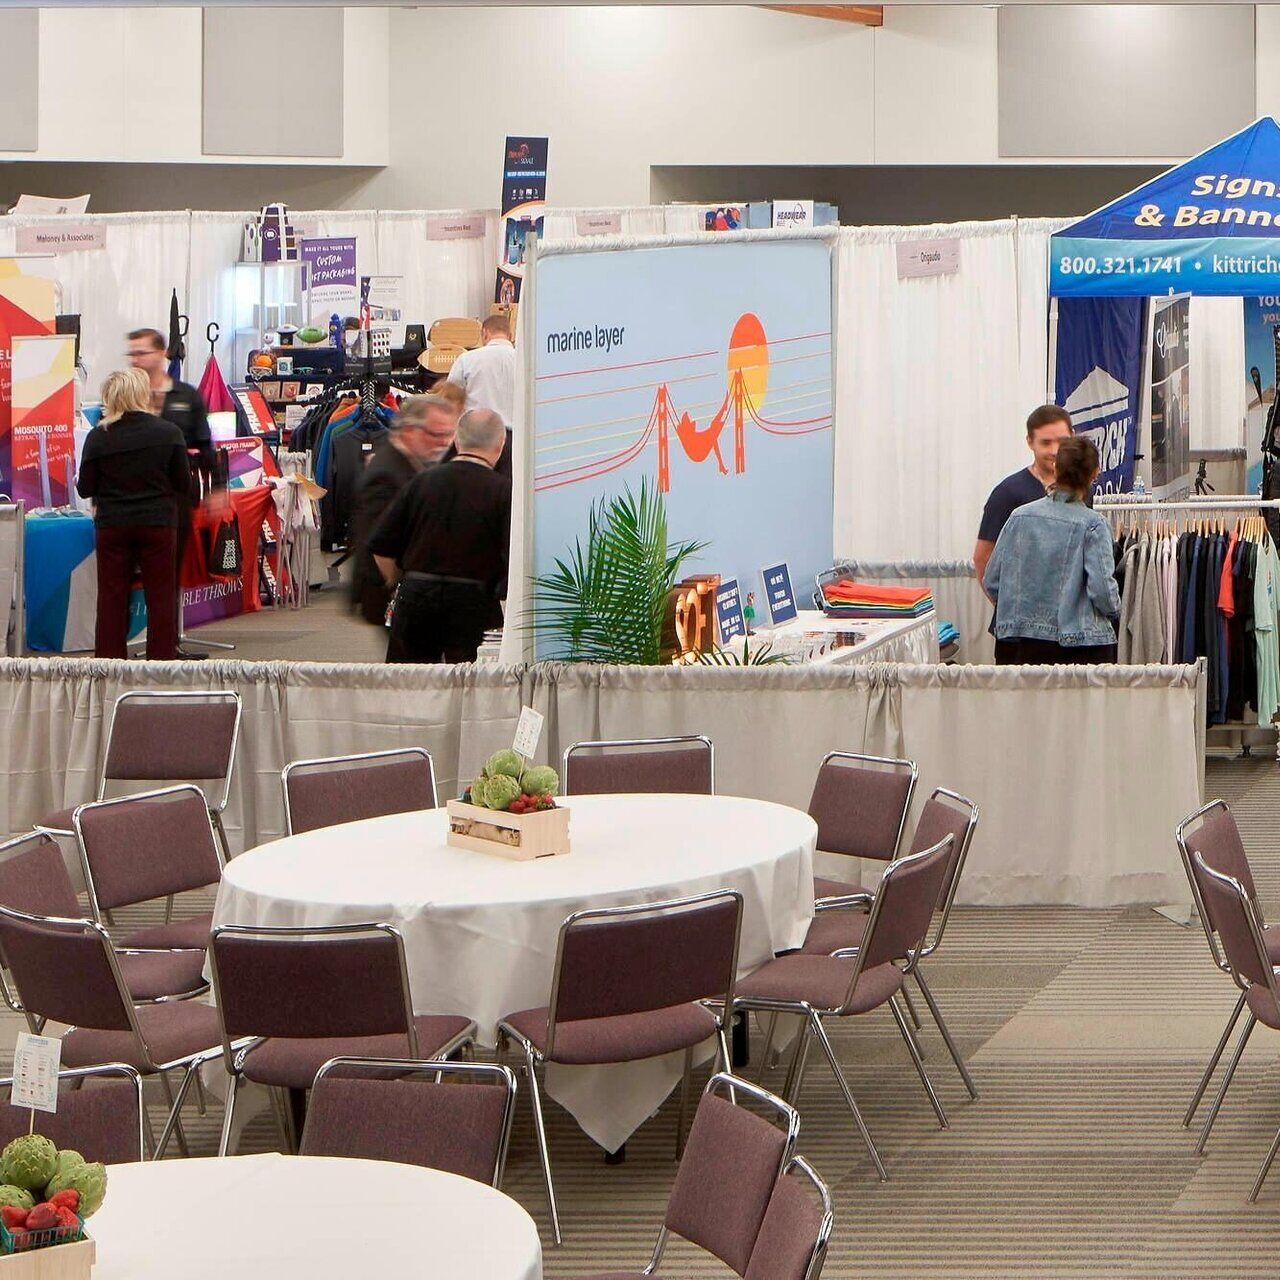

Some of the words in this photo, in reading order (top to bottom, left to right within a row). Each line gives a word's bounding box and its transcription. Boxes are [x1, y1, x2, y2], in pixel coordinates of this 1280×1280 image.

[777, 211, 807, 220] HEADWEAR
[1133, 203, 1165, 227] &
[67, 232, 94, 242] Associates
[316, 254, 342, 267] CUSTOM
[1059, 256, 1182, 274] 800.321.1741
[321, 266, 355, 280] PACKAGING
[547, 326, 592, 353] marine
[595, 324, 625, 353] layer
[14, 425, 52, 435] MOSQUITO
[182, 590, 201, 607] BLE
[204, 577, 243, 602] THROWS
